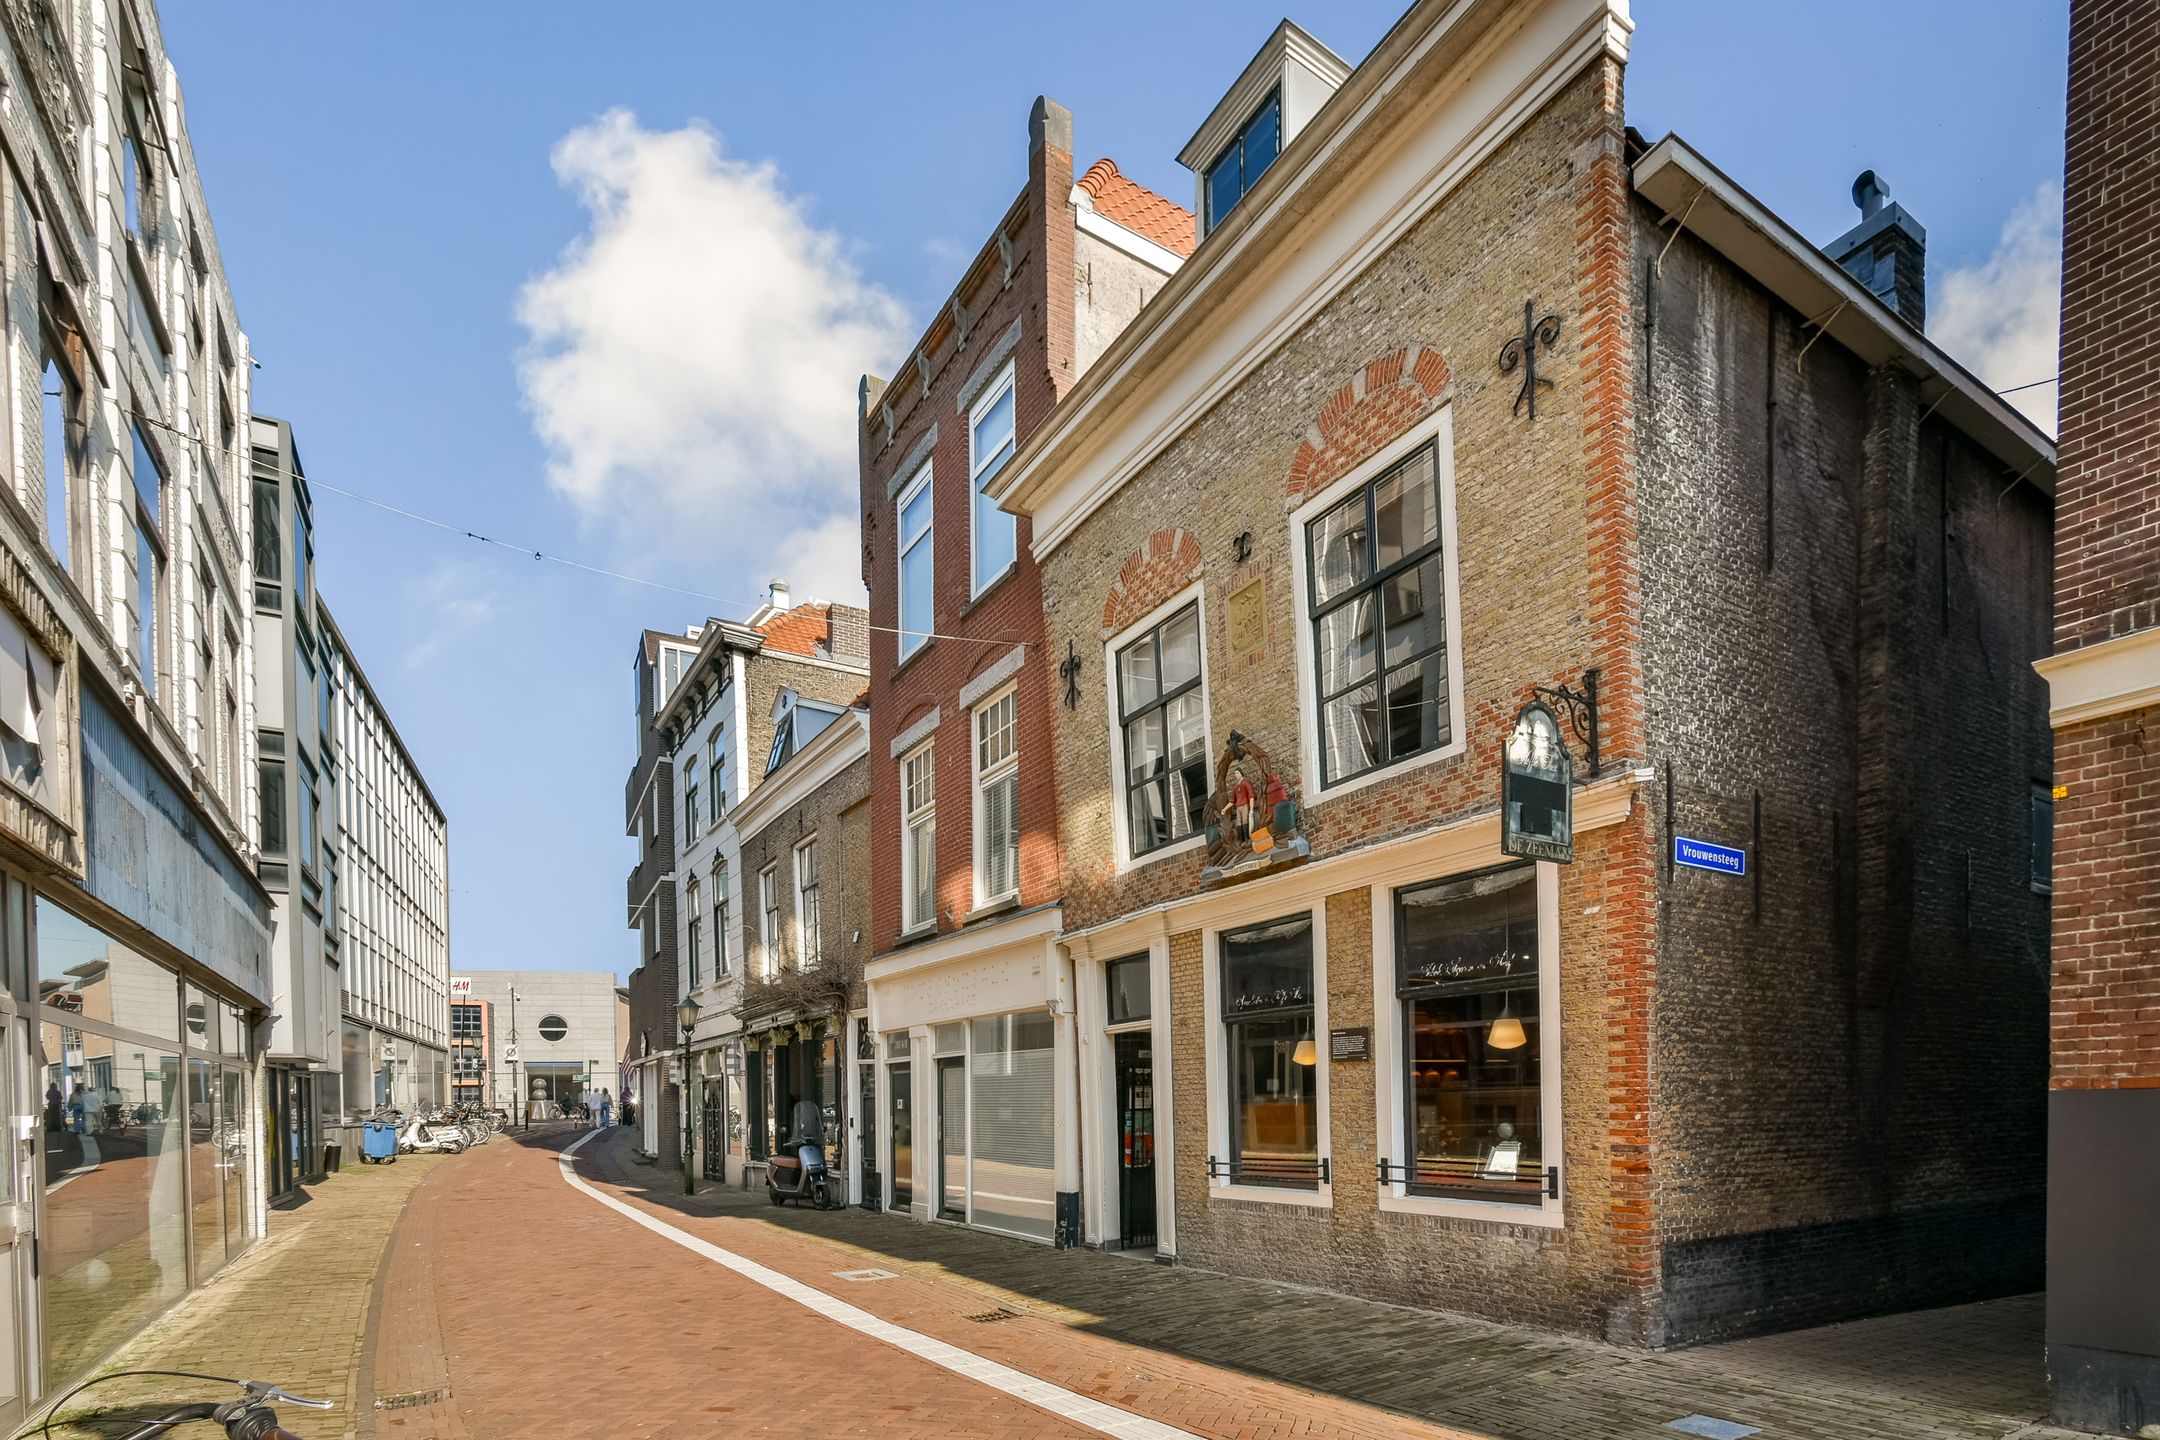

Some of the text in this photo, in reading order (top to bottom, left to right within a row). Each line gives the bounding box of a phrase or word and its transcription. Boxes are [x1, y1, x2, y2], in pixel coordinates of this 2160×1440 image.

[1508, 837, 1571, 861] DE ZEEMAN
[1682, 844, 1740, 870] Vrouwensteeg
